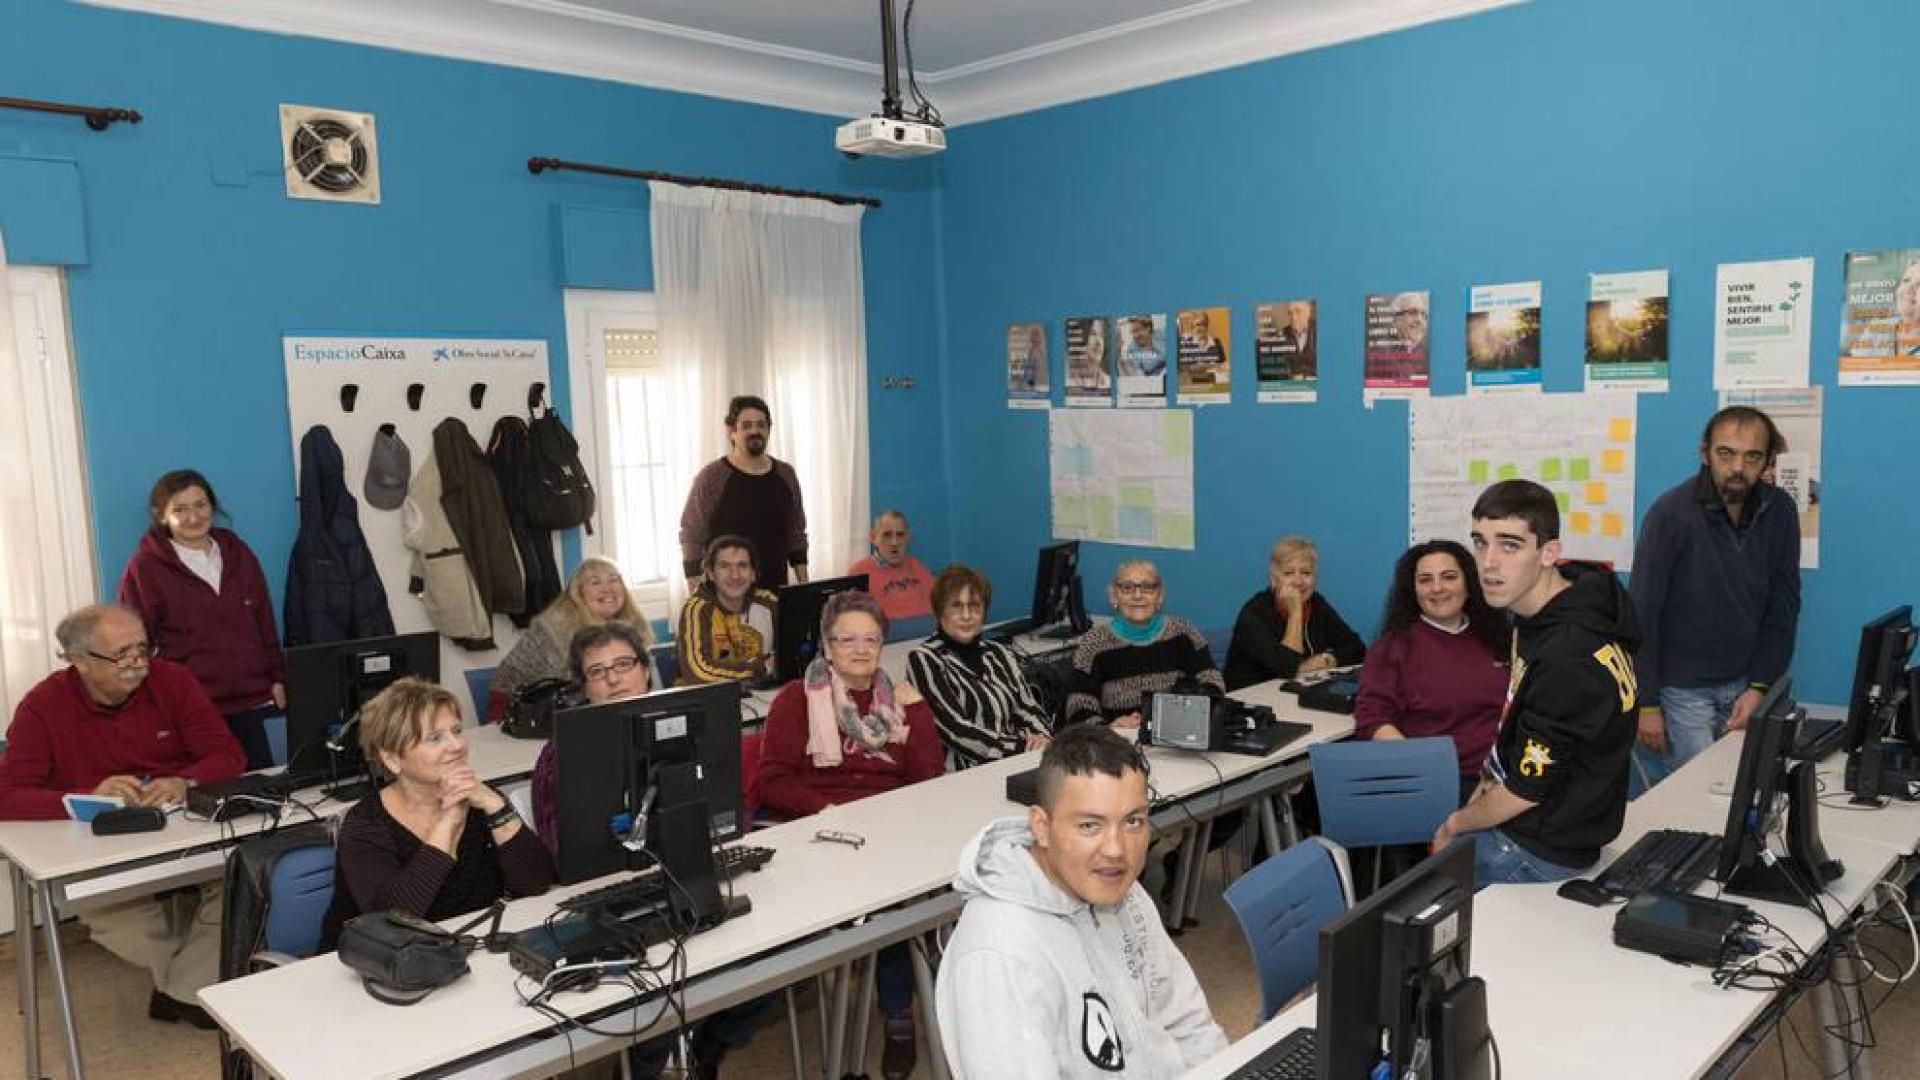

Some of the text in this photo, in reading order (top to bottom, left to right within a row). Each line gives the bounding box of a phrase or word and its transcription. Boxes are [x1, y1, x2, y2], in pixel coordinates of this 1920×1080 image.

[1727, 283, 1756, 292] VIVIR
[1727, 304, 1774, 315] SENTIRSE
[1727, 316, 1762, 325] MEJOR
